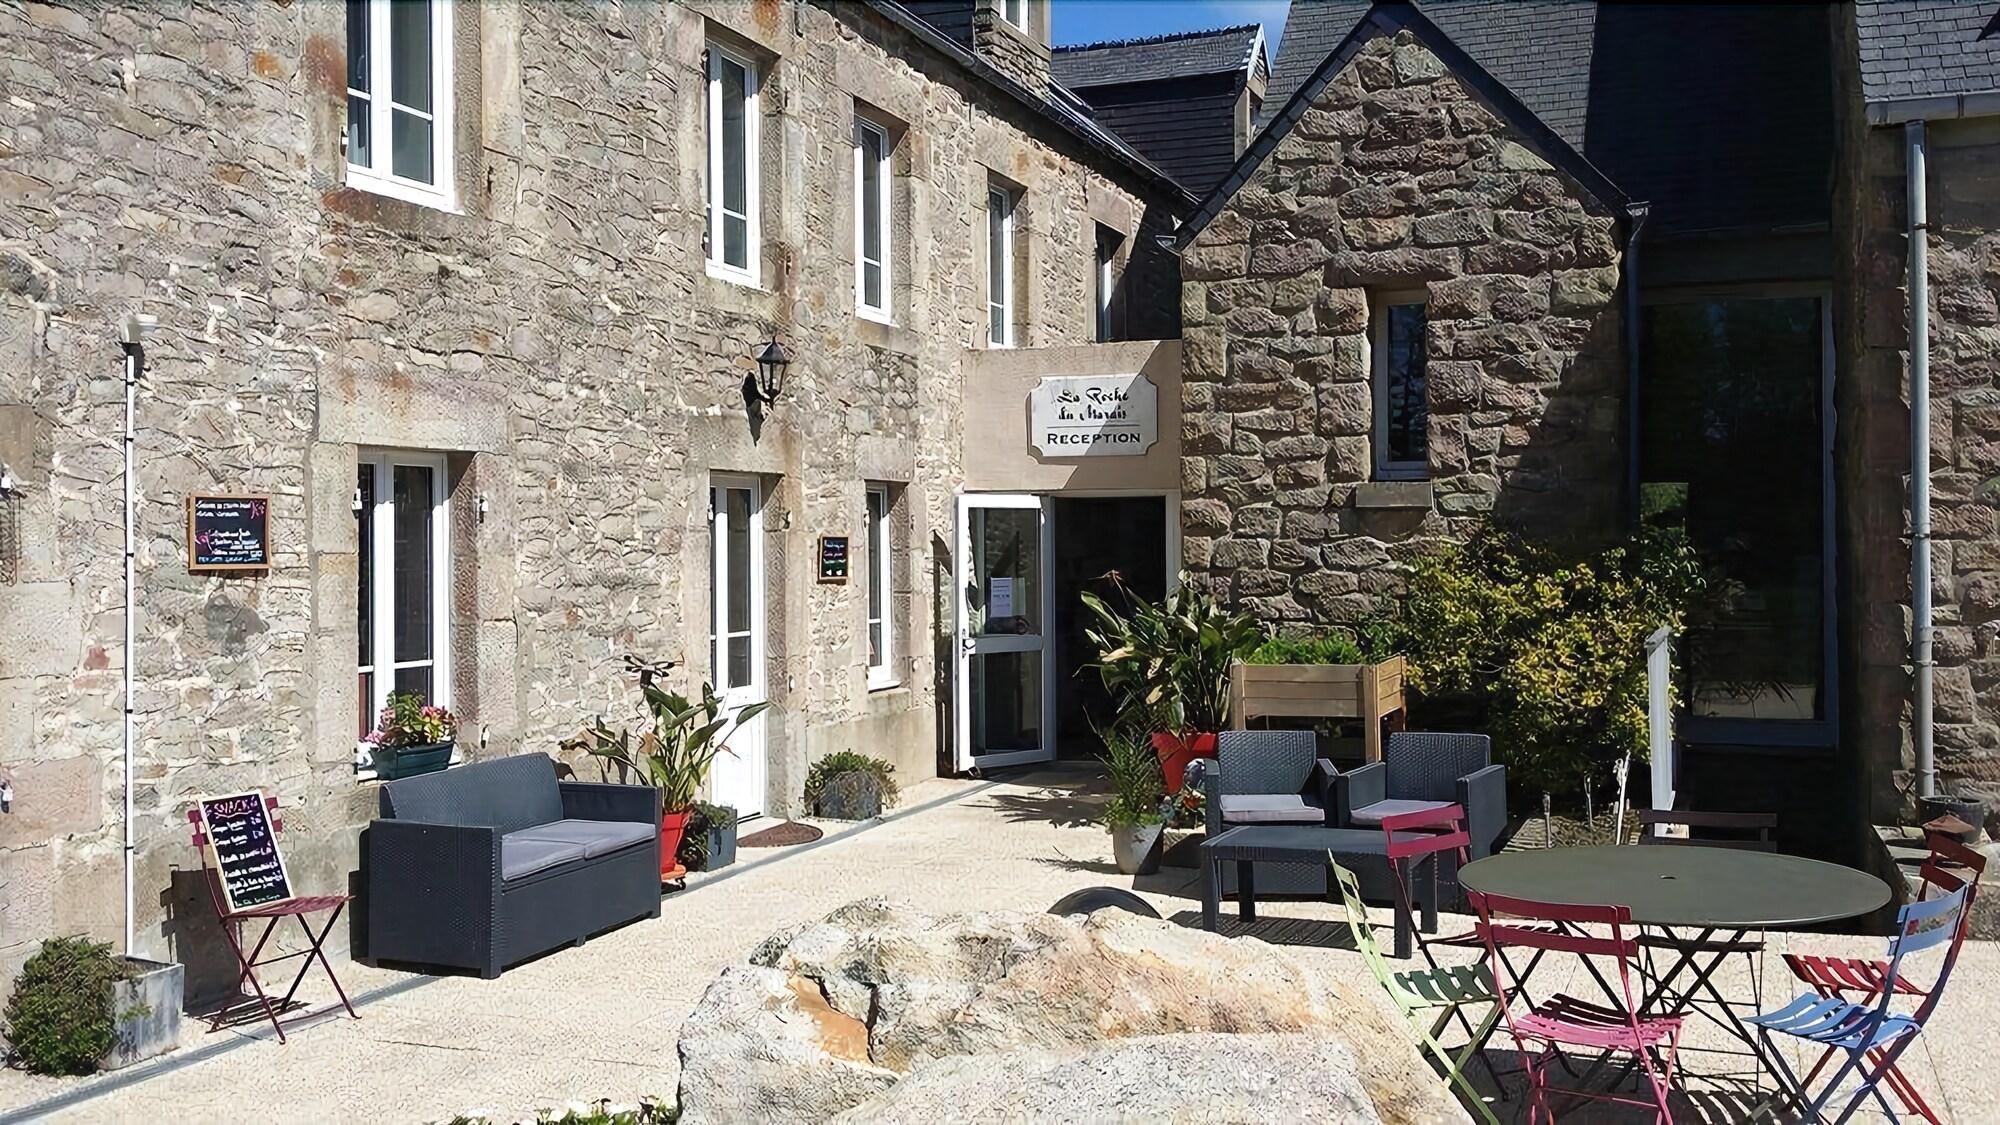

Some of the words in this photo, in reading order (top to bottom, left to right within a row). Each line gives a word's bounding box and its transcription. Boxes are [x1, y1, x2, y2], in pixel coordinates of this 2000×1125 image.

[1056, 389, 1081, 404] La
[1085, 387, 1130, 405] Roche
[1079, 404, 1128, 421] Marais
[1046, 433, 1141, 445] RECEPTION
